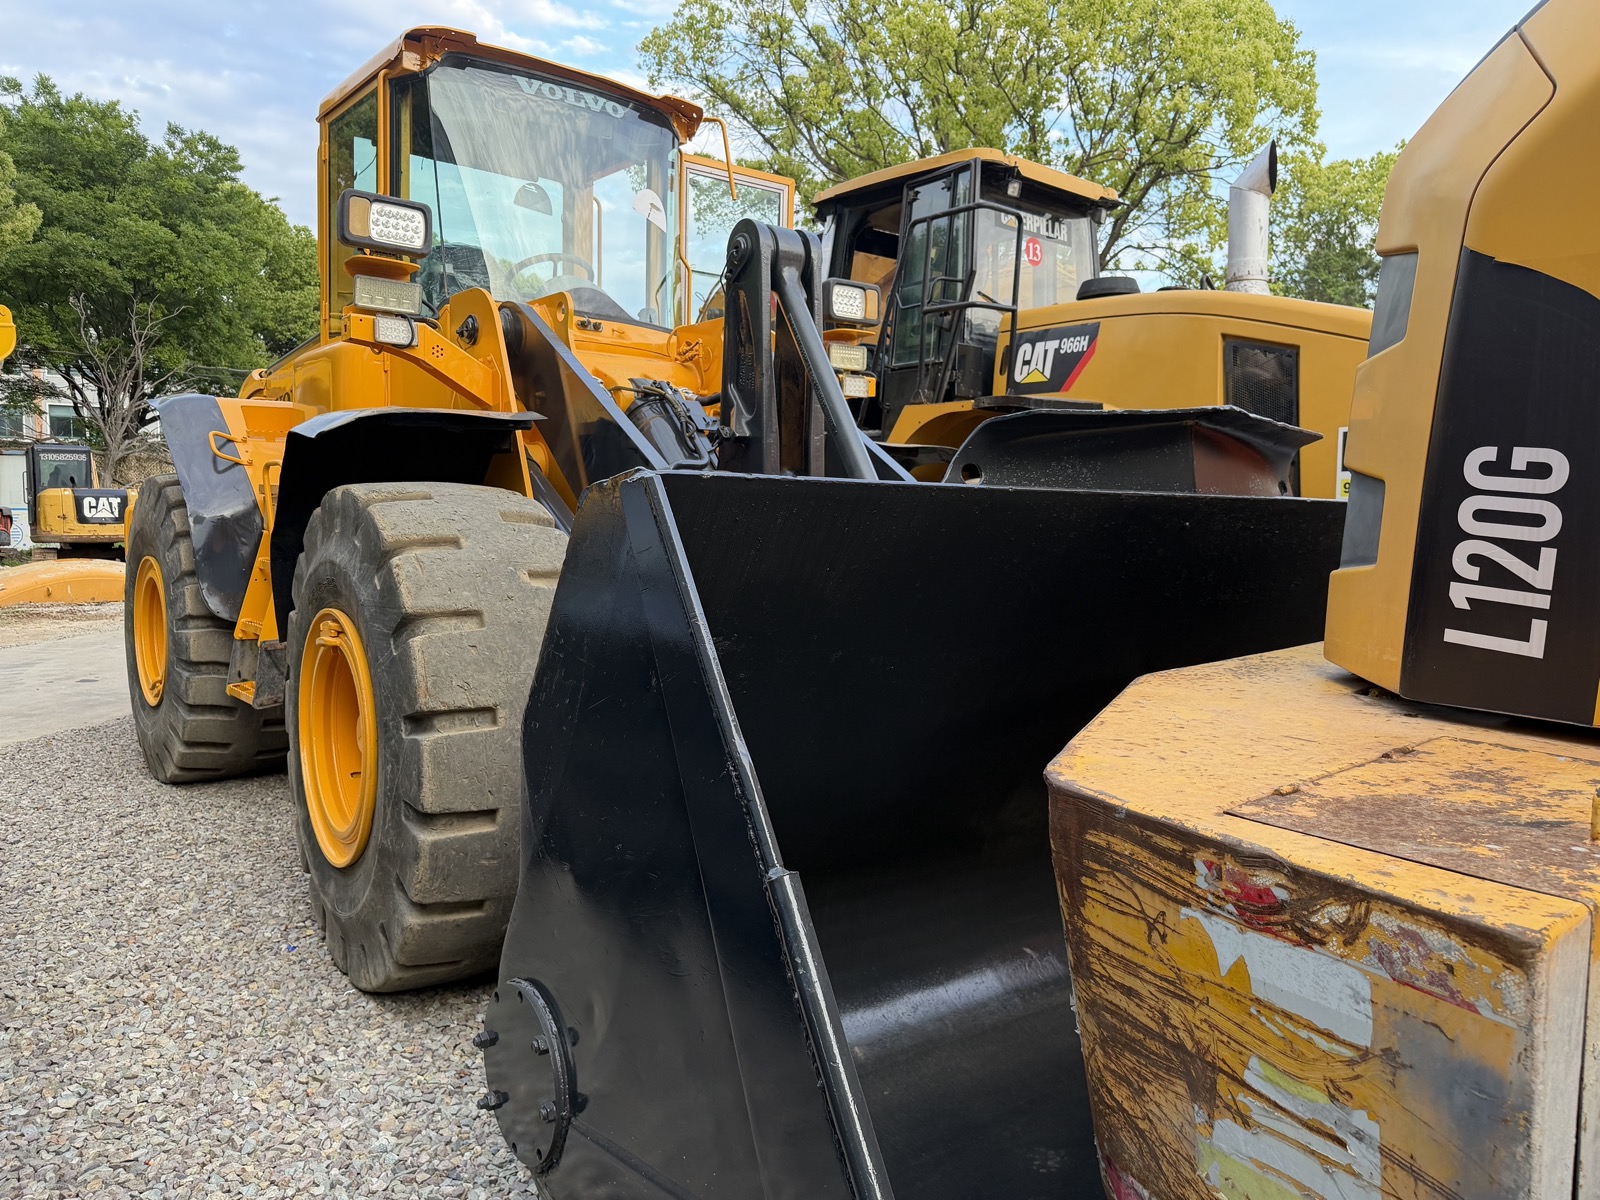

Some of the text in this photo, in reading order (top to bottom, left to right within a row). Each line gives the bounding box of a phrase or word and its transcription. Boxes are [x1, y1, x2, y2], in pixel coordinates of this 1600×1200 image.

[511, 74, 625, 119] VOLVO
[1001, 211, 1068, 241] CAERPILLAR
[1027, 242, 1041, 262] 13
[1014, 335, 1089, 383] CAT 966H
[83, 497, 121, 518] CAT
[1443, 446, 1570, 659] L120G
